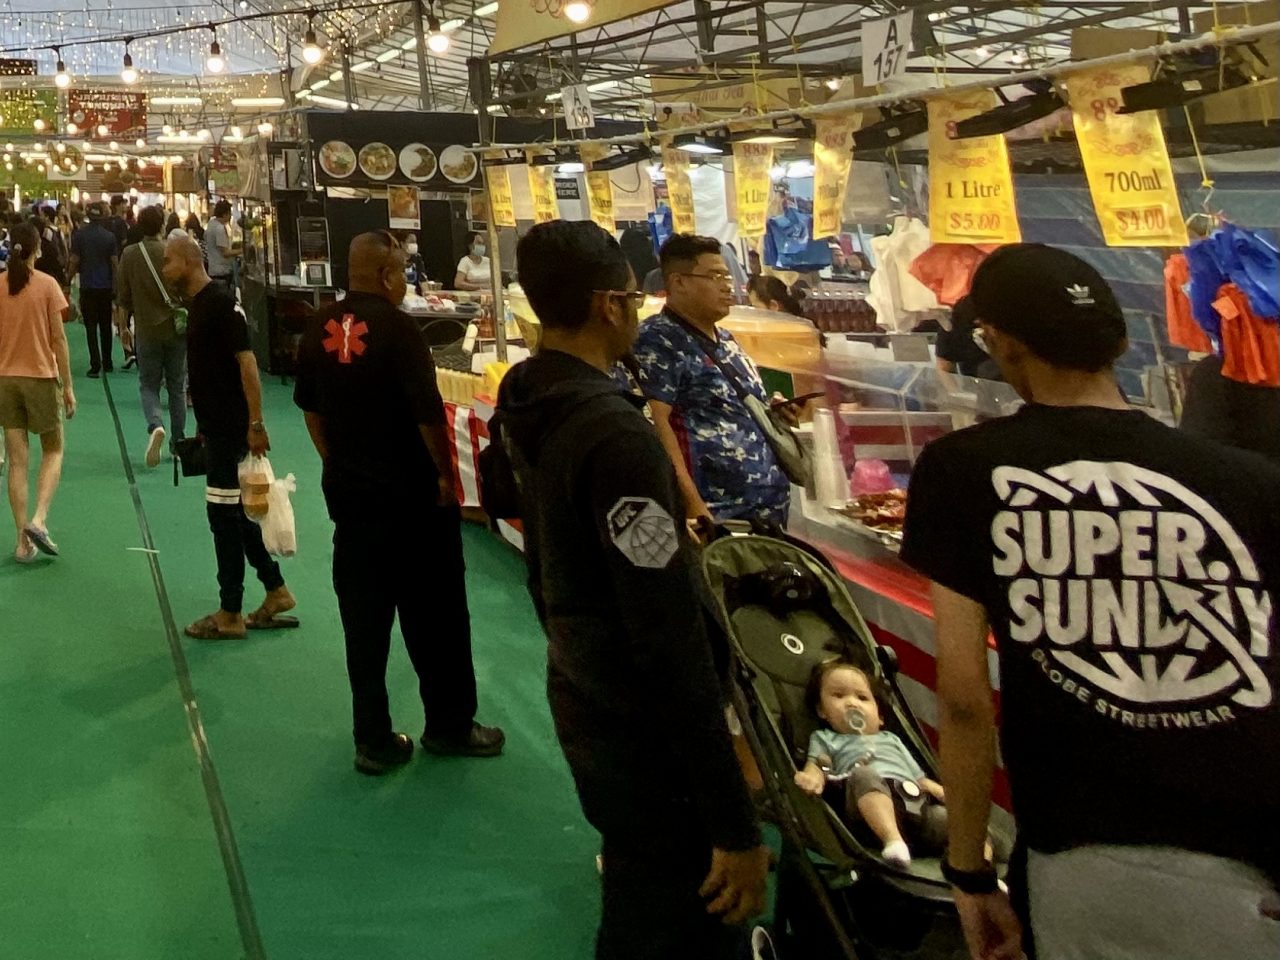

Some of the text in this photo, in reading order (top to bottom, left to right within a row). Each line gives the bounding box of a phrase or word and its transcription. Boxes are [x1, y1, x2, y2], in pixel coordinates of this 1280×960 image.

[884, 19, 898, 49] A
[873, 45, 904, 81] 157
[945, 180, 1001, 199] 1 Litre
[1105, 168, 1162, 193] 700ml
[1116, 208, 1165, 231] $4.00
[1095, 704, 1236, 730] STREETWEAR
